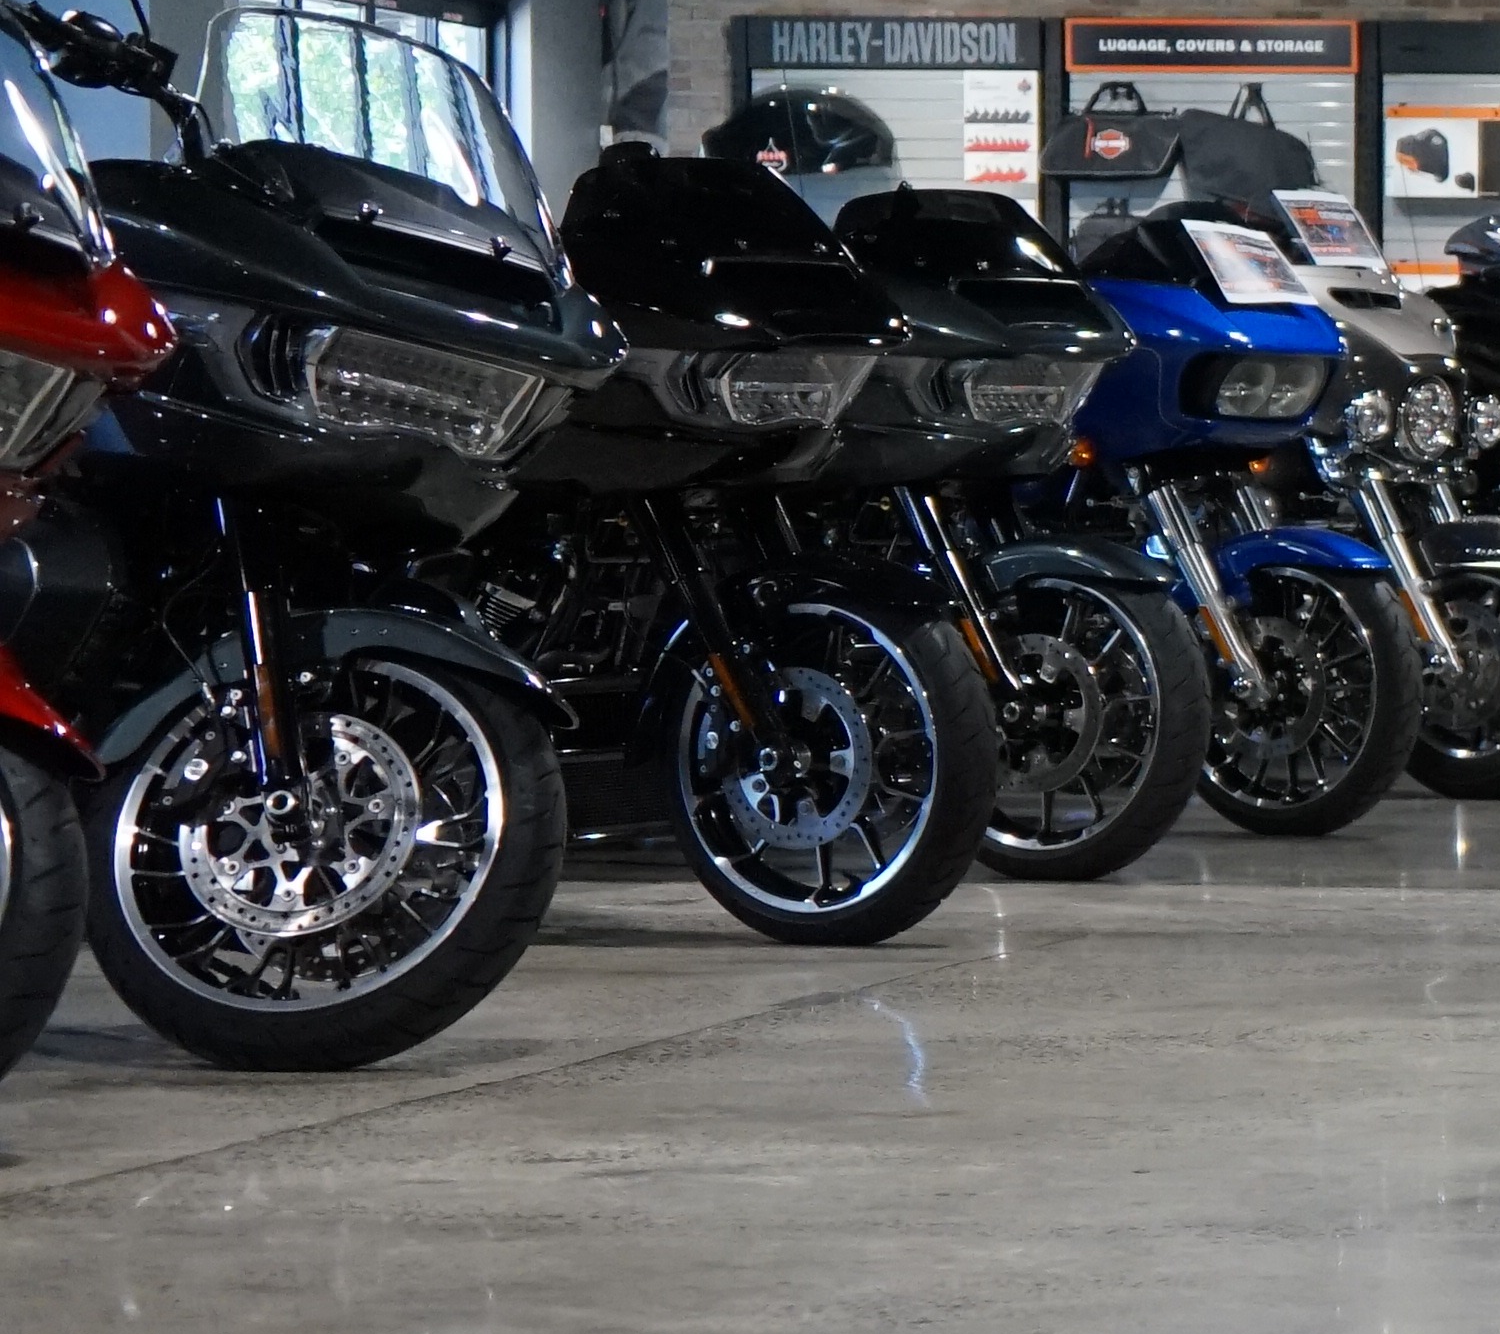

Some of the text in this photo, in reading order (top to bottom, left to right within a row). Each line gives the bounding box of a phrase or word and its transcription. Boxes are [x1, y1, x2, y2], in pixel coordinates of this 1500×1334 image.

[771, 21, 1017, 64] HARLEY-DAVIDSON
[1098, 38, 1325, 54] LUGGAGE, COVERS & STORAGE
